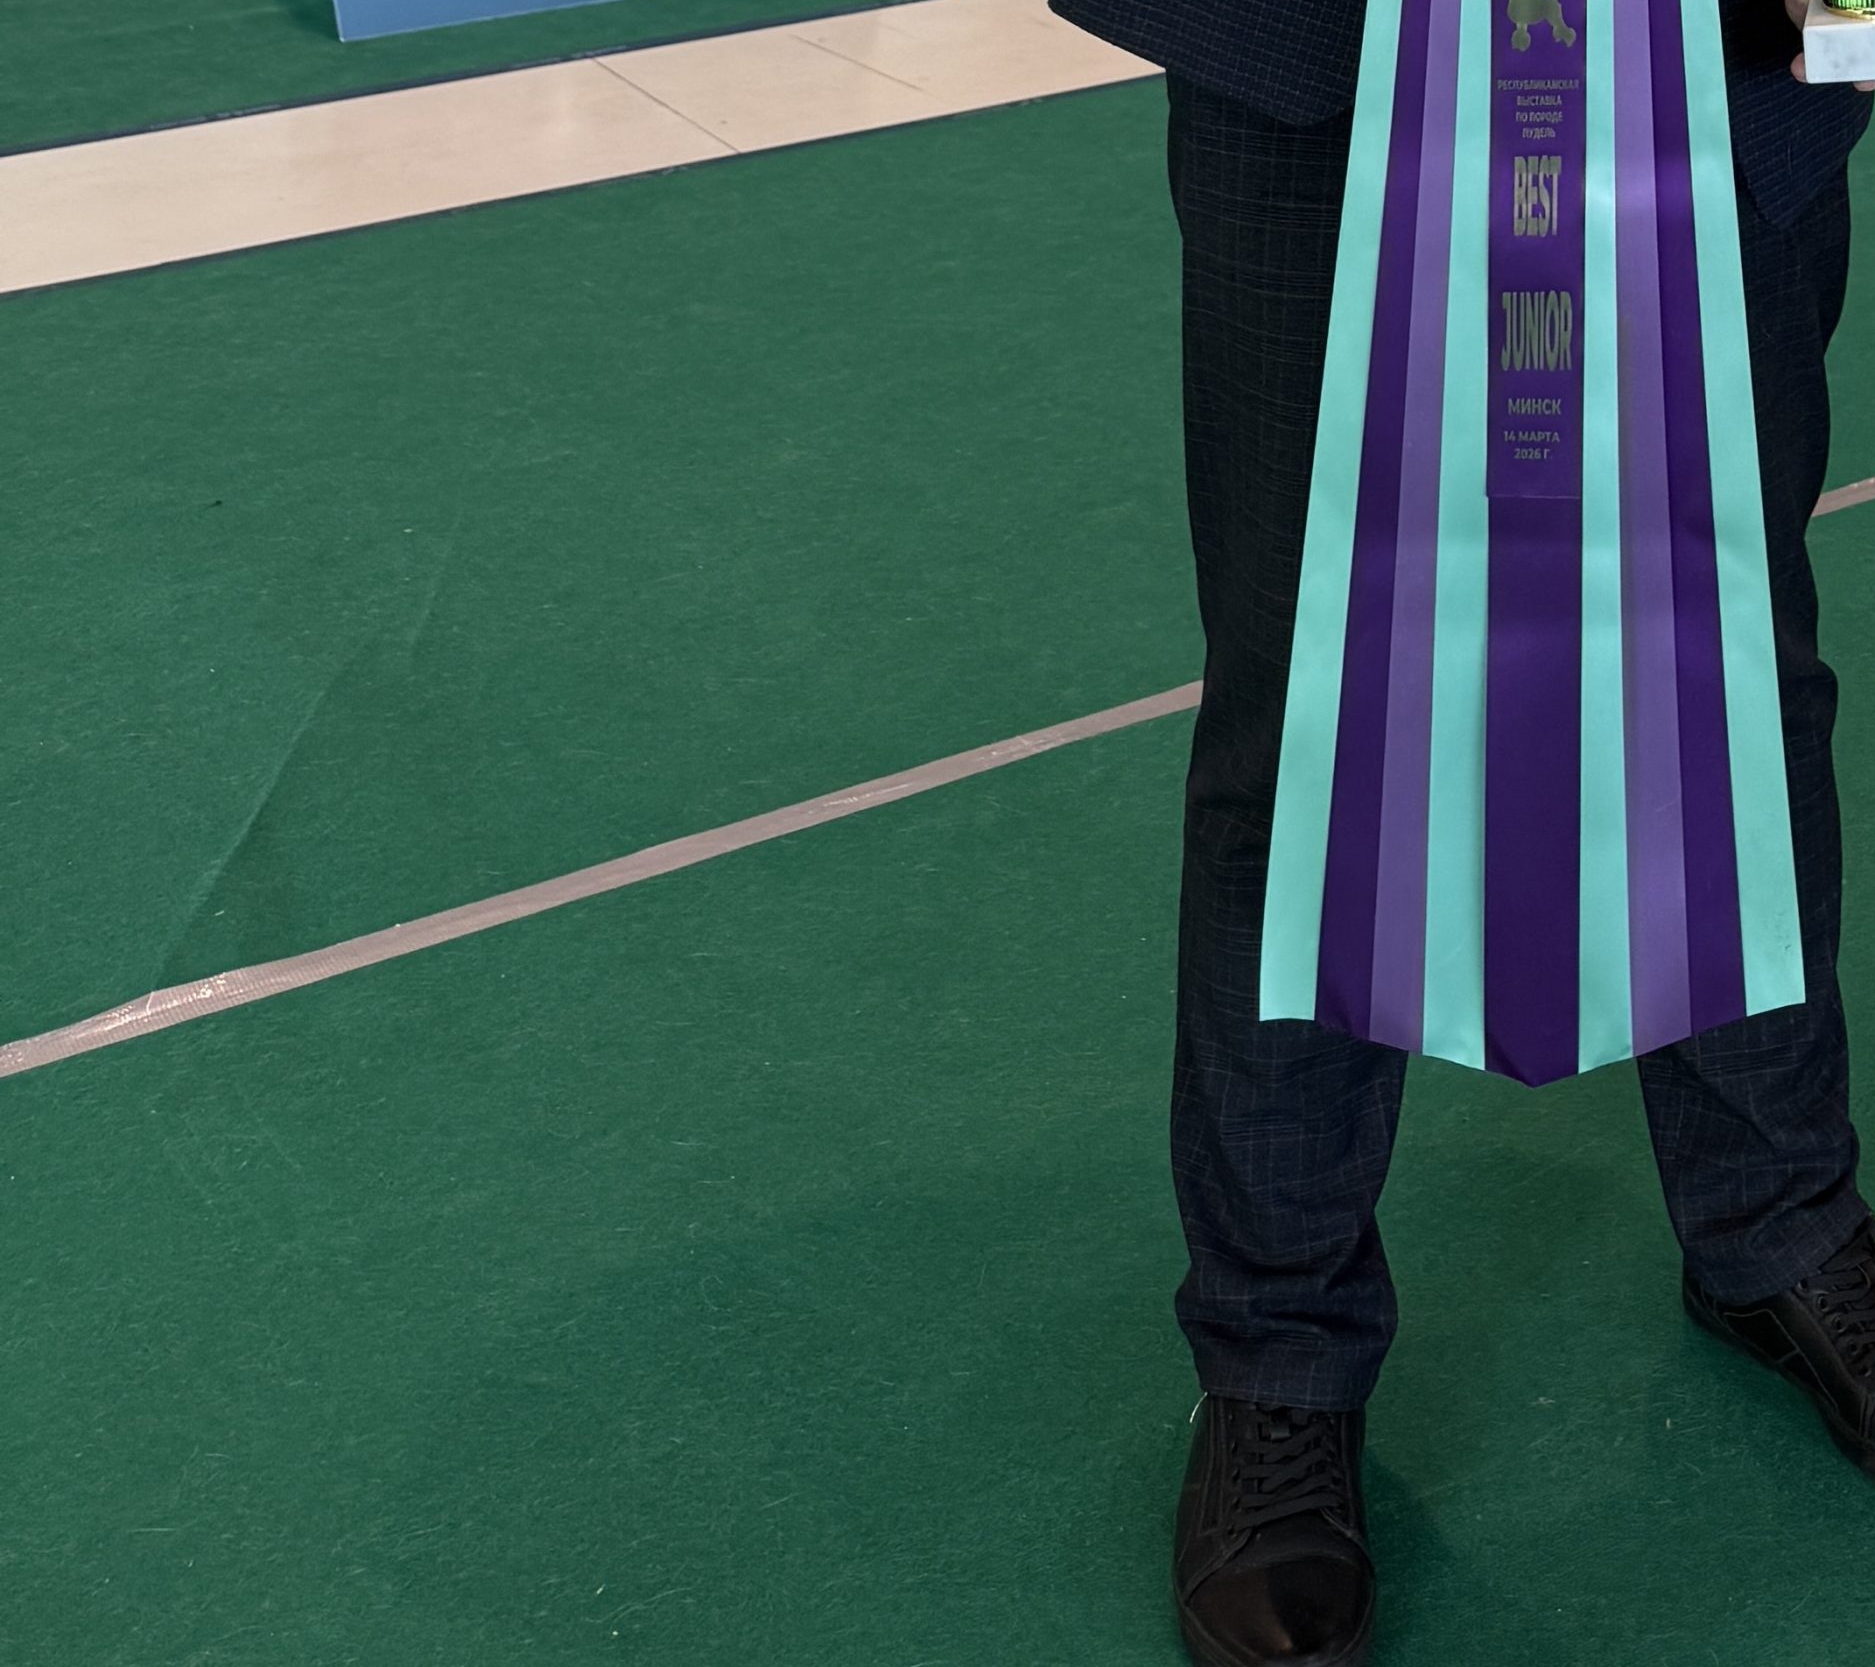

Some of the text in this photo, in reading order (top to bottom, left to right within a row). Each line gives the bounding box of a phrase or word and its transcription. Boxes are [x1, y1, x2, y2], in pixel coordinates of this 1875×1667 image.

[1513, 155, 1562, 237] BEST
[1501, 290, 1573, 371] JUNIOR
[1508, 397, 1562, 415] МИНСК
[1504, 430, 1560, 442] 14 МАРТА
[1514, 448, 1541, 460] 2026
